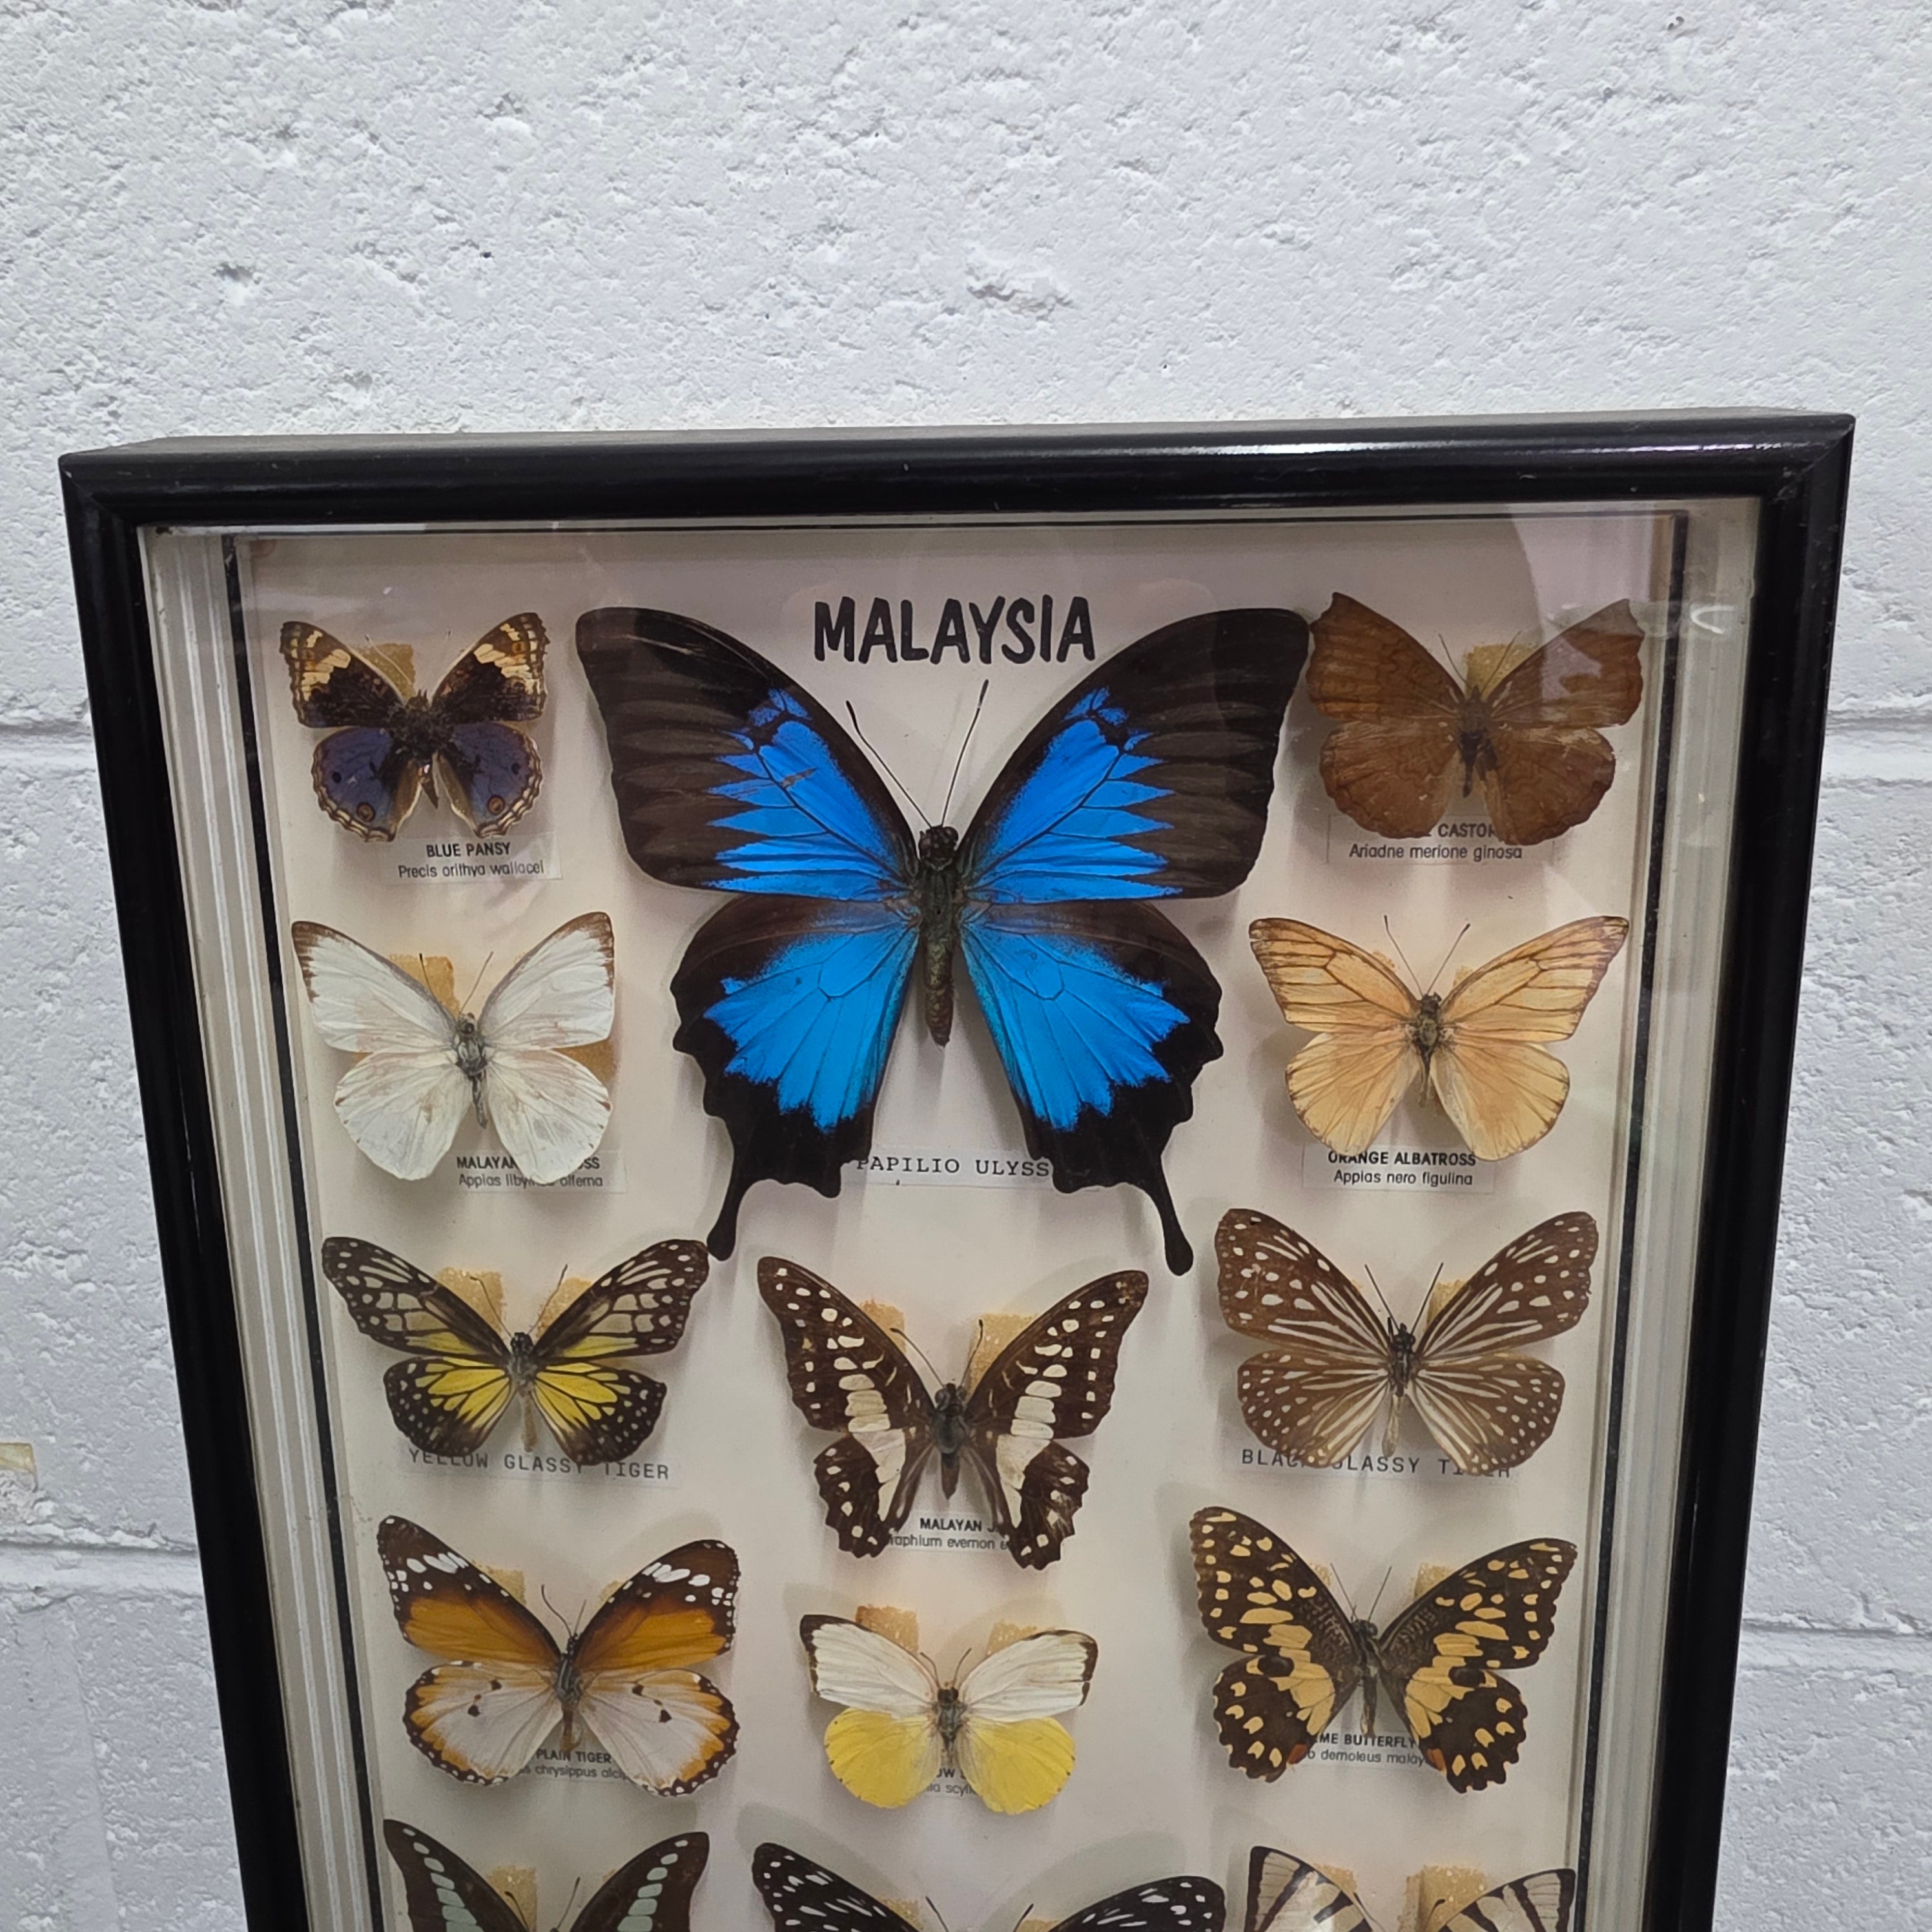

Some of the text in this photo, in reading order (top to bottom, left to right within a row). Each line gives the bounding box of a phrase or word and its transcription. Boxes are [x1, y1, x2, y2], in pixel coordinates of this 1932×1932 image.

[815, 594, 1095, 664] MALAYSIA
[426, 842, 511, 858] BLUE PANSY
[1350, 843, 1522, 862] Ariadne merione ginosa
[398, 864, 437, 878] Precis
[489, 859, 544, 876] wallacei
[1328, 1151, 1476, 1166] ORANGE ALBATROSS
[976, 1160, 1050, 1177] ULYSS
[1387, 1173, 1416, 1184] nero
[1423, 1171, 1472, 1187] figulina
[1242, 1449, 1304, 1468] BLAC
[920, 1517, 982, 1532] MALAYAN
[890, 1534, 943, 1548] raphium
[535, 1748, 611, 1763] PLAIN TIGER
[1321, 1749, 1381, 1763] demoleus
